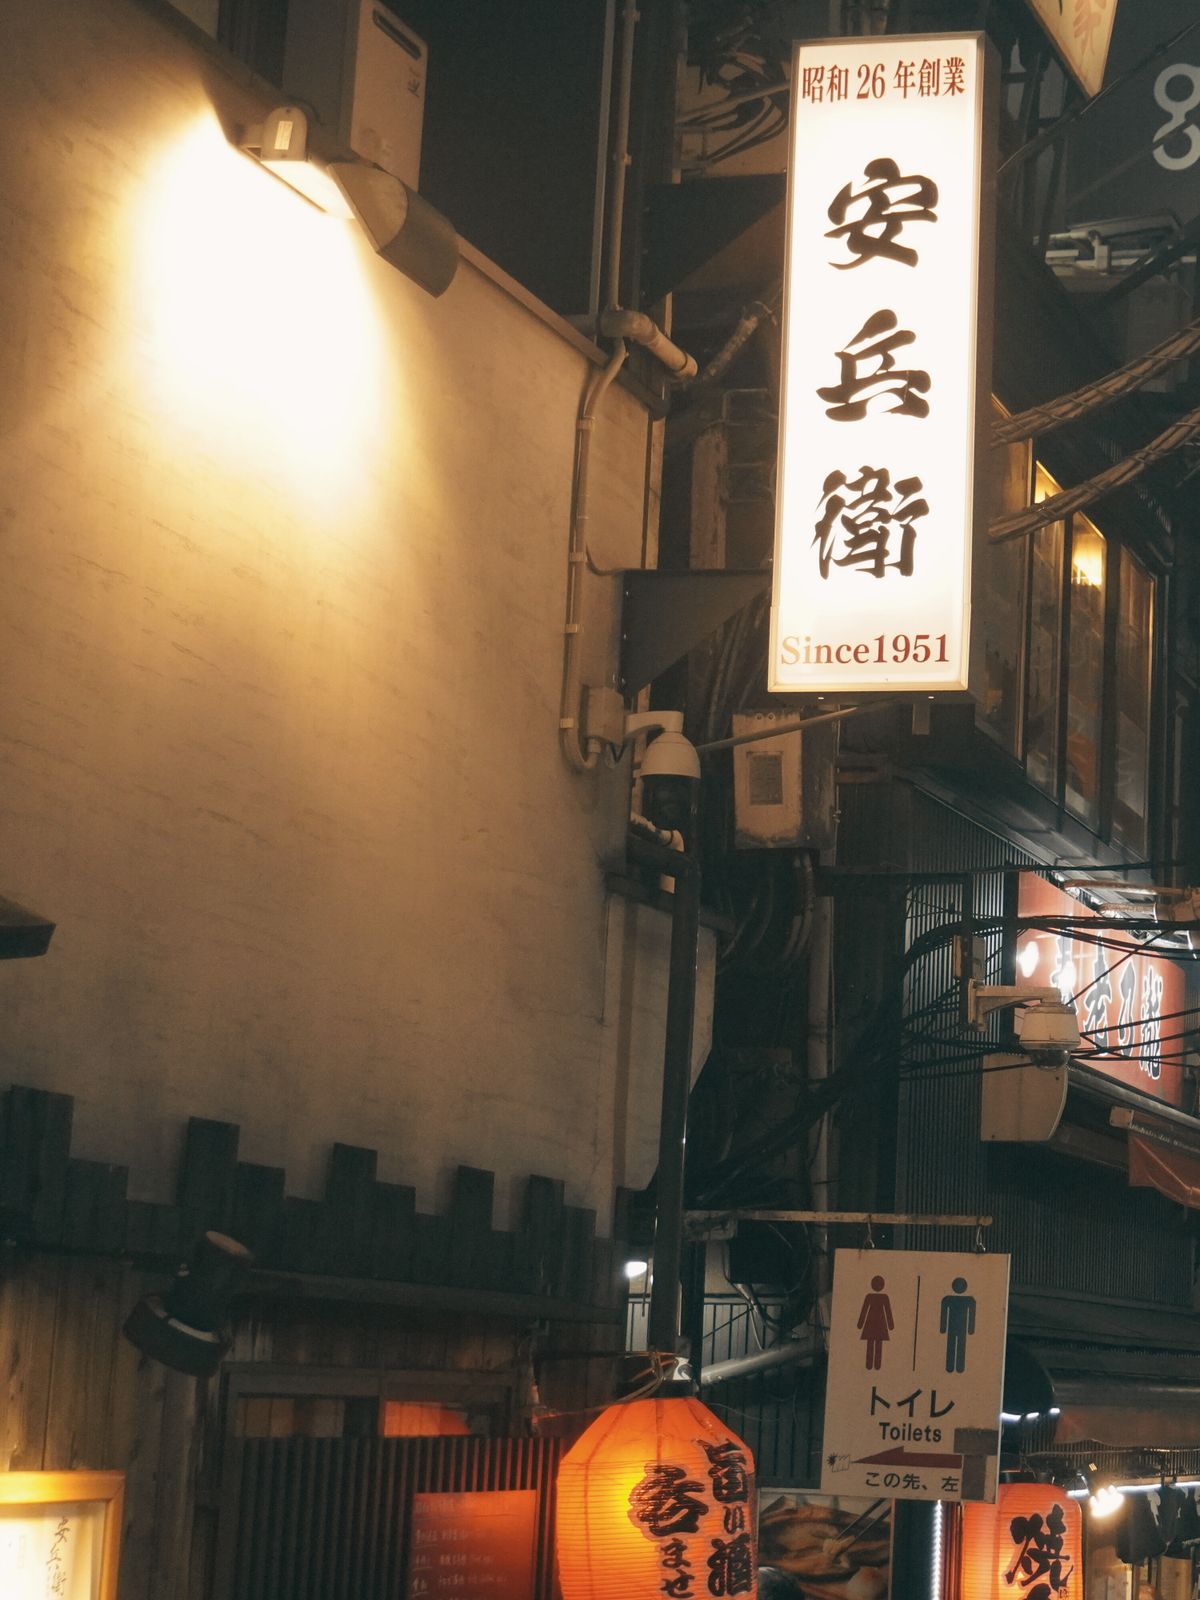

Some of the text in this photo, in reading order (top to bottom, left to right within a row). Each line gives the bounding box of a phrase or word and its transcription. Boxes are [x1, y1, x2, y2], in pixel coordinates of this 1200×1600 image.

[802, 57, 966, 103] 昭和26年創業
[811, 158, 938, 579] 安兵衛
[780, 633, 950, 665] Since1951
[868, 1386, 955, 1419] トイレ
[879, 1421, 943, 1444] Toilets
[865, 1472, 959, 1493] この先、左
[1004, 1503, 1074, 1600] 焼
